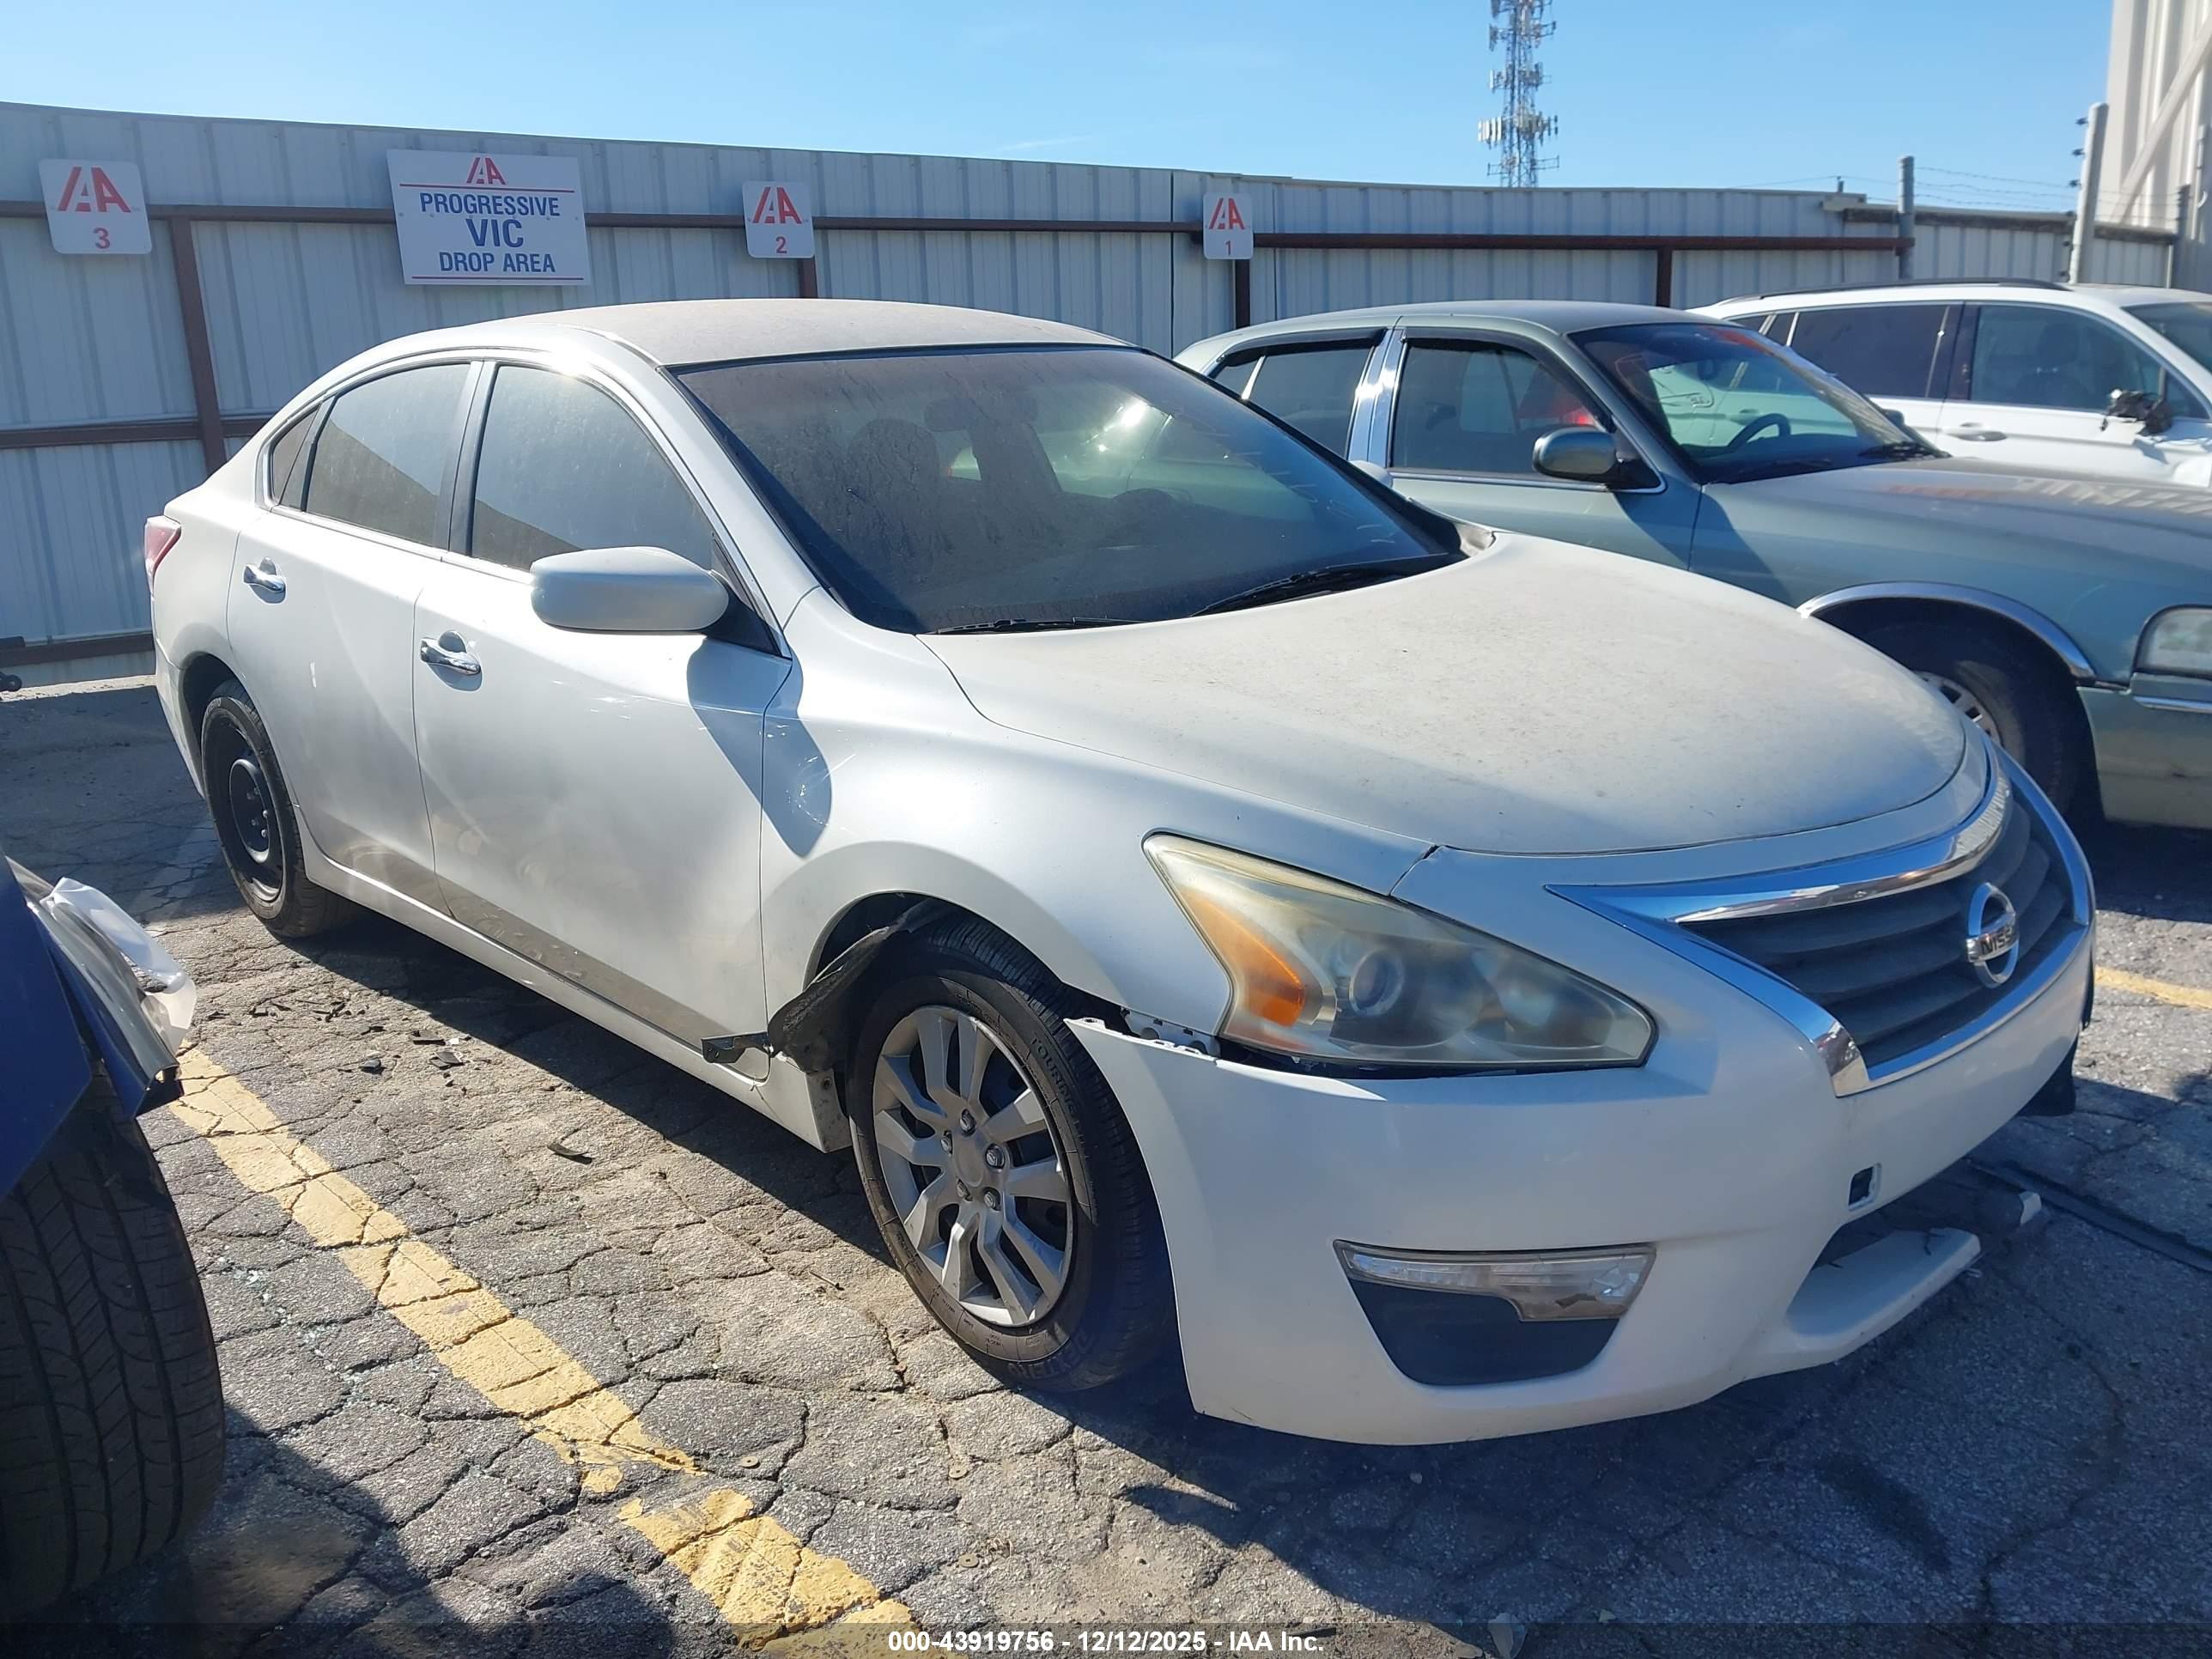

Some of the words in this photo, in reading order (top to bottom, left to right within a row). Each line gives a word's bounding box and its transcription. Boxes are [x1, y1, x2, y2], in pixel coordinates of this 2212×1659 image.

[420, 192, 560, 216] PROGRESSIVE
[93, 228, 111, 249] 3
[465, 218, 524, 247] VIC
[775, 236, 787, 253] 2
[1225, 240, 1231, 255] 1
[439, 252, 495, 272] DROP
[502, 253, 556, 273] AREA
